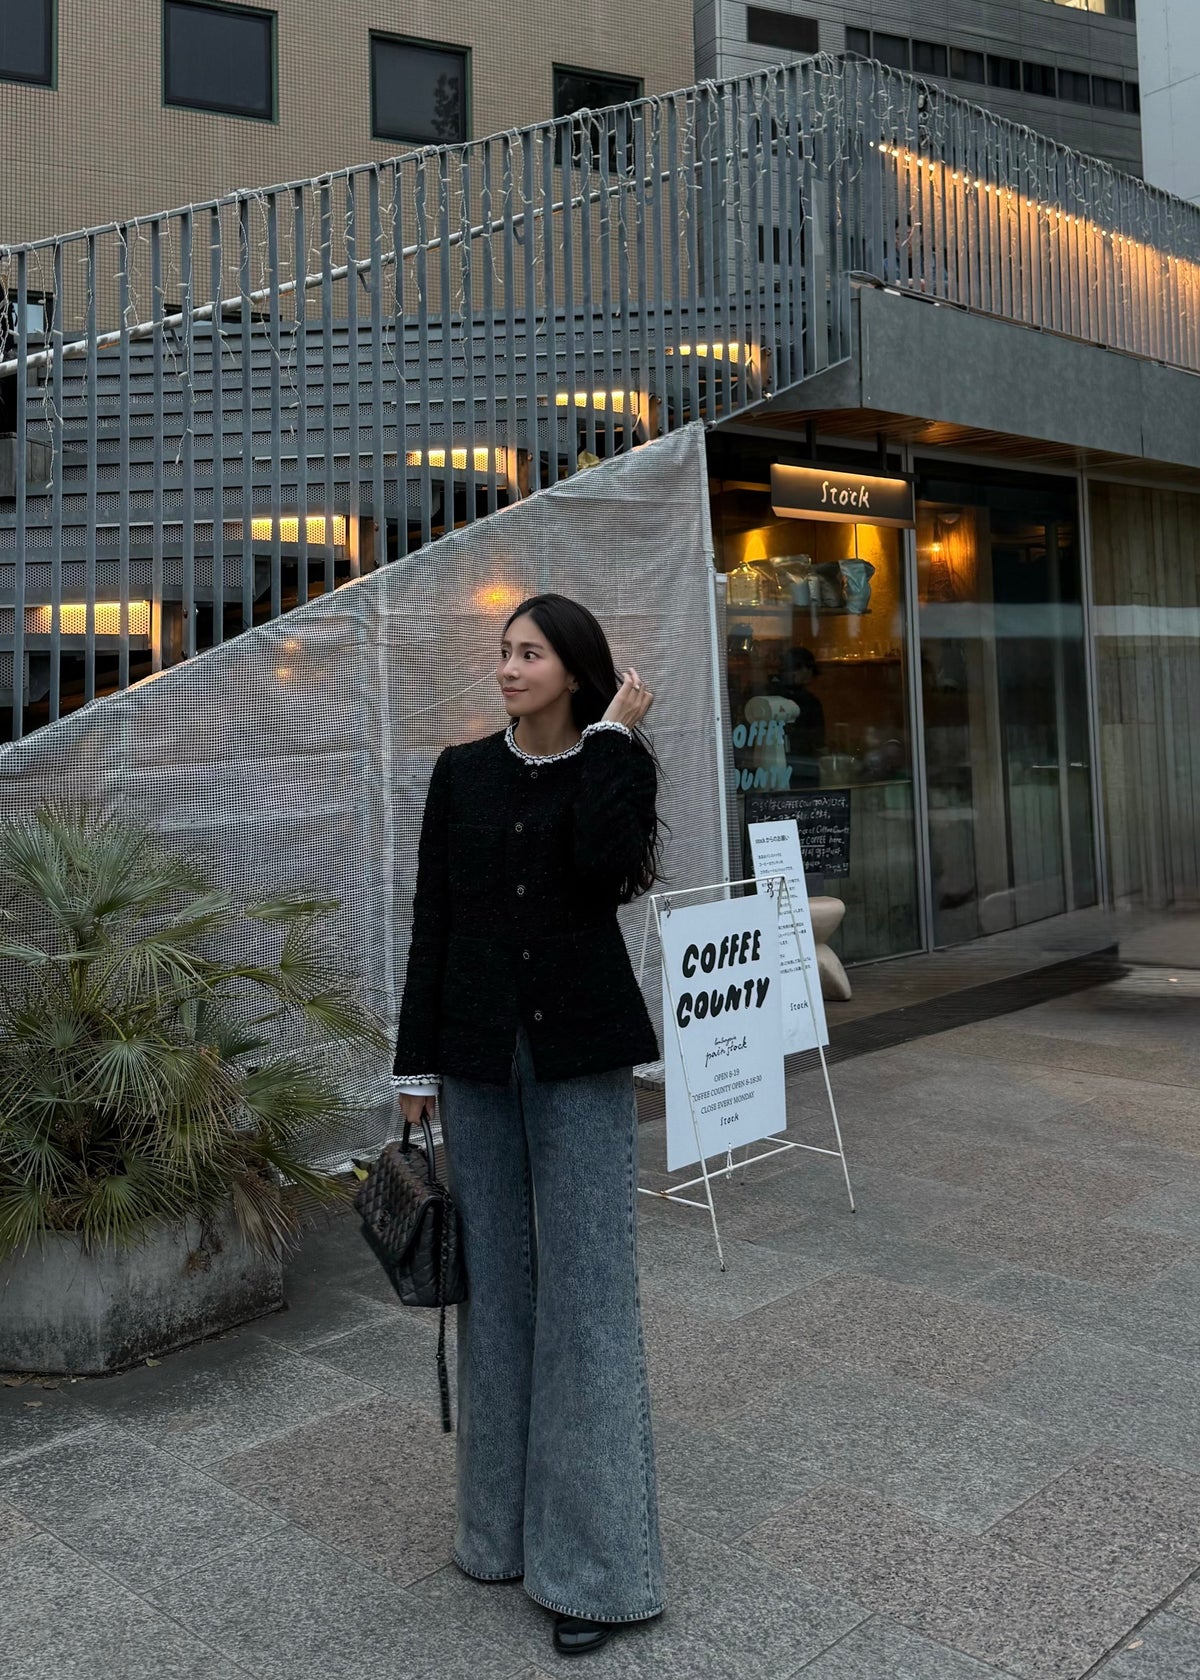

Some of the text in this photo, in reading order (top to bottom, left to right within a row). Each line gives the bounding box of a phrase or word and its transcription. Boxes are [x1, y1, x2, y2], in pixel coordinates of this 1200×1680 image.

[733, 720, 786, 748] OFFEE
[734, 765, 793, 791] UNTY
[682, 929, 762, 979] COFFEE
[676, 976, 770, 1028] COUNTY
[710, 1083, 731, 1097] COUNTY
[713, 1072, 729, 1082] OPEN
[701, 1103, 717, 1114] CLOSE
